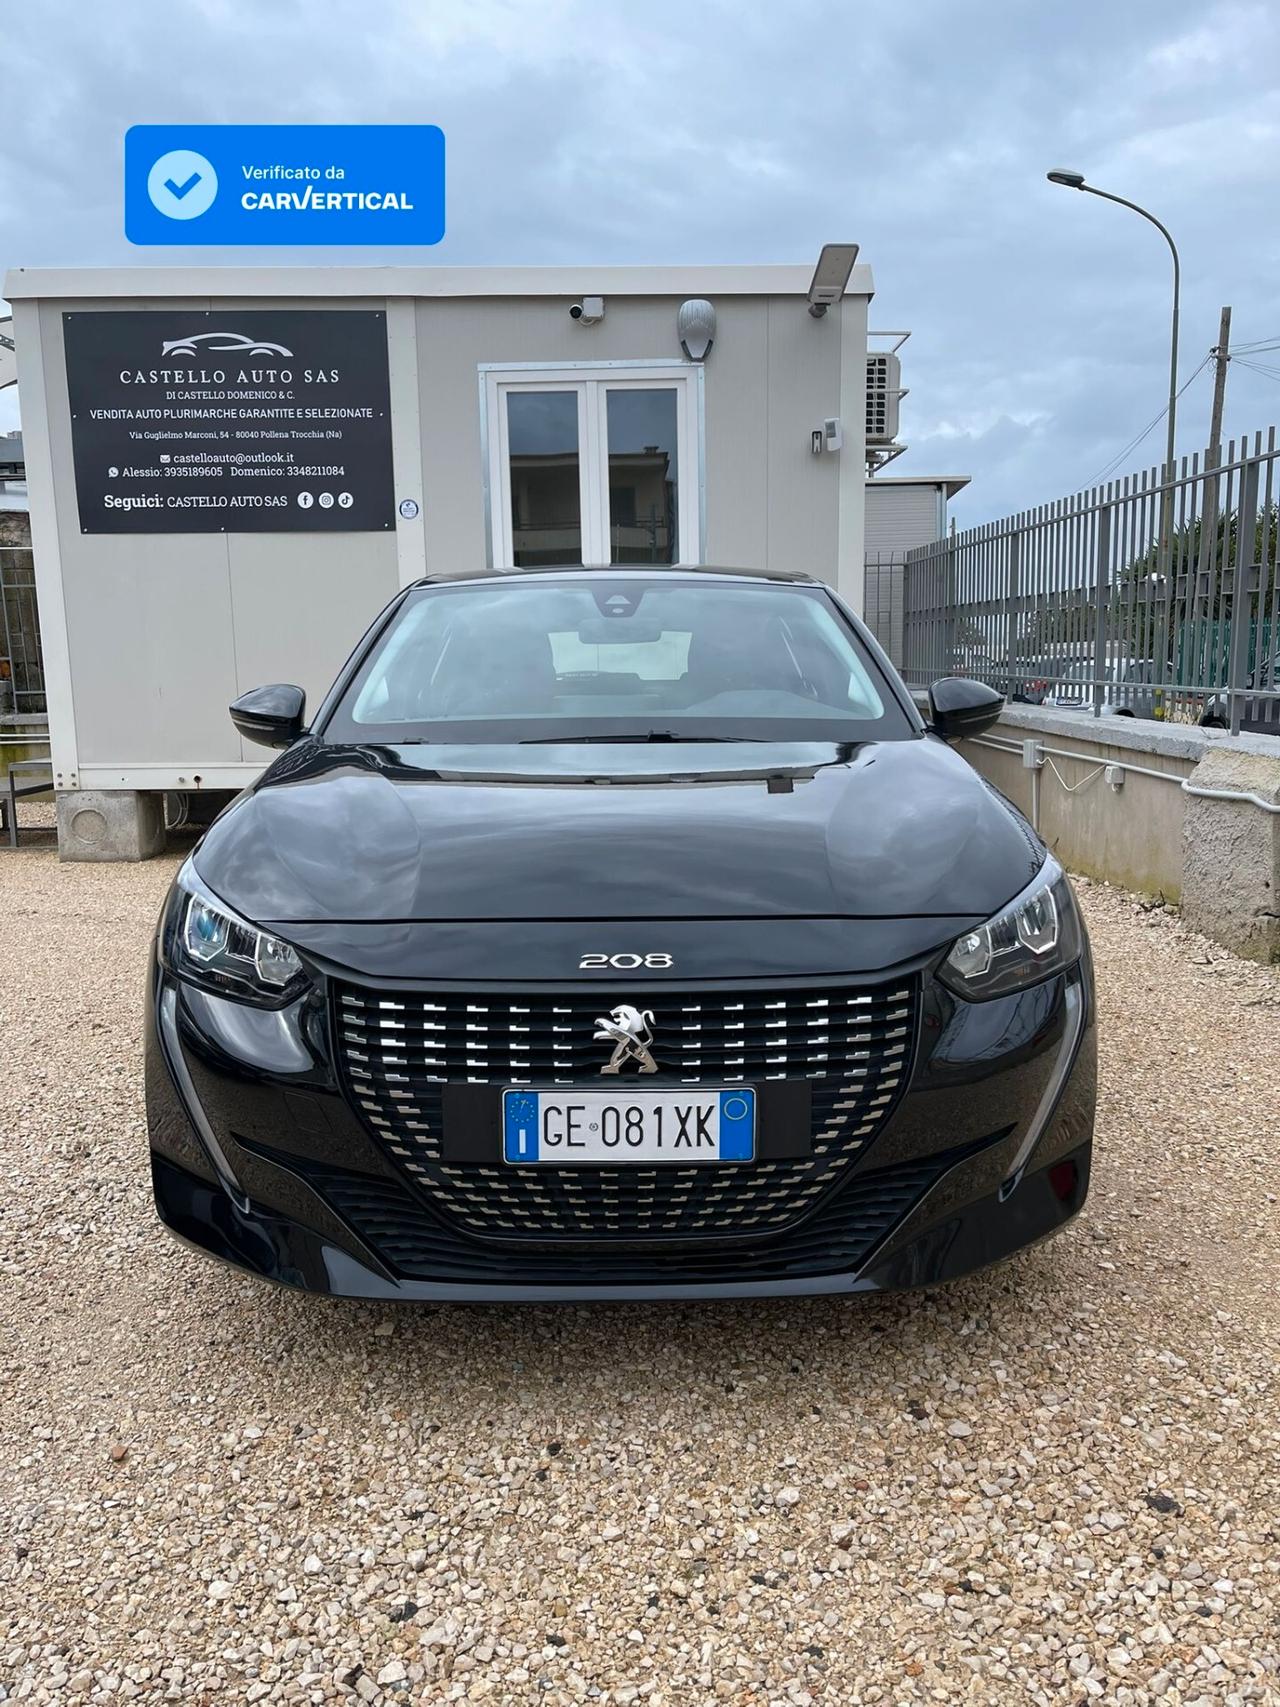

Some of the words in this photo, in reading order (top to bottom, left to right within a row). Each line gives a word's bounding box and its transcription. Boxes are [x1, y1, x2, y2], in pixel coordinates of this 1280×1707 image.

[120, 370, 226, 384] CASTELLO
[237, 370, 293, 384] AUTO
[304, 370, 339, 383] SAS
[166, 391, 176, 400] DI
[177, 391, 226, 400] CASTELLO
[227, 390, 277, 400] DOMENICO
[278, 391, 285, 399] &
[287, 391, 295, 399] C.
[90, 409, 134, 419] VENDITA
[135, 409, 162, 419] AUTO
[163, 409, 237, 419] PLURIMARCHE
[239, 408, 295, 419] GARANTITE
[296, 408, 303, 418] E
[304, 408, 373, 418] SELEZIONATE
[129, 431, 143, 439] Via
[144, 431, 183, 441] Guglielmo
[184, 431, 219, 440] Marconi,
[220, 431, 229, 439] 54
[235, 431, 259, 439] 80040
[260, 430, 289, 439] Pollena
[290, 430, 325, 439] Trocchia
[325, 430, 342, 440] (Na)
[173, 452, 295, 465] castelloauto@outlook.it
[122, 467, 163, 477] Alessio:
[164, 466, 223, 477] 3935189605
[230, 466, 286, 477] Domenico:
[286, 466, 345, 476] 3348211084
[104, 493, 164, 511] Seguici:
[167, 496, 228, 508] CASTELLO
[229, 496, 263, 507] AUTO
[263, 495, 288, 507] SAS
[579, 953, 674, 969] 208
[543, 1105, 586, 1147] GE
[601, 1105, 716, 1148] 081XK
